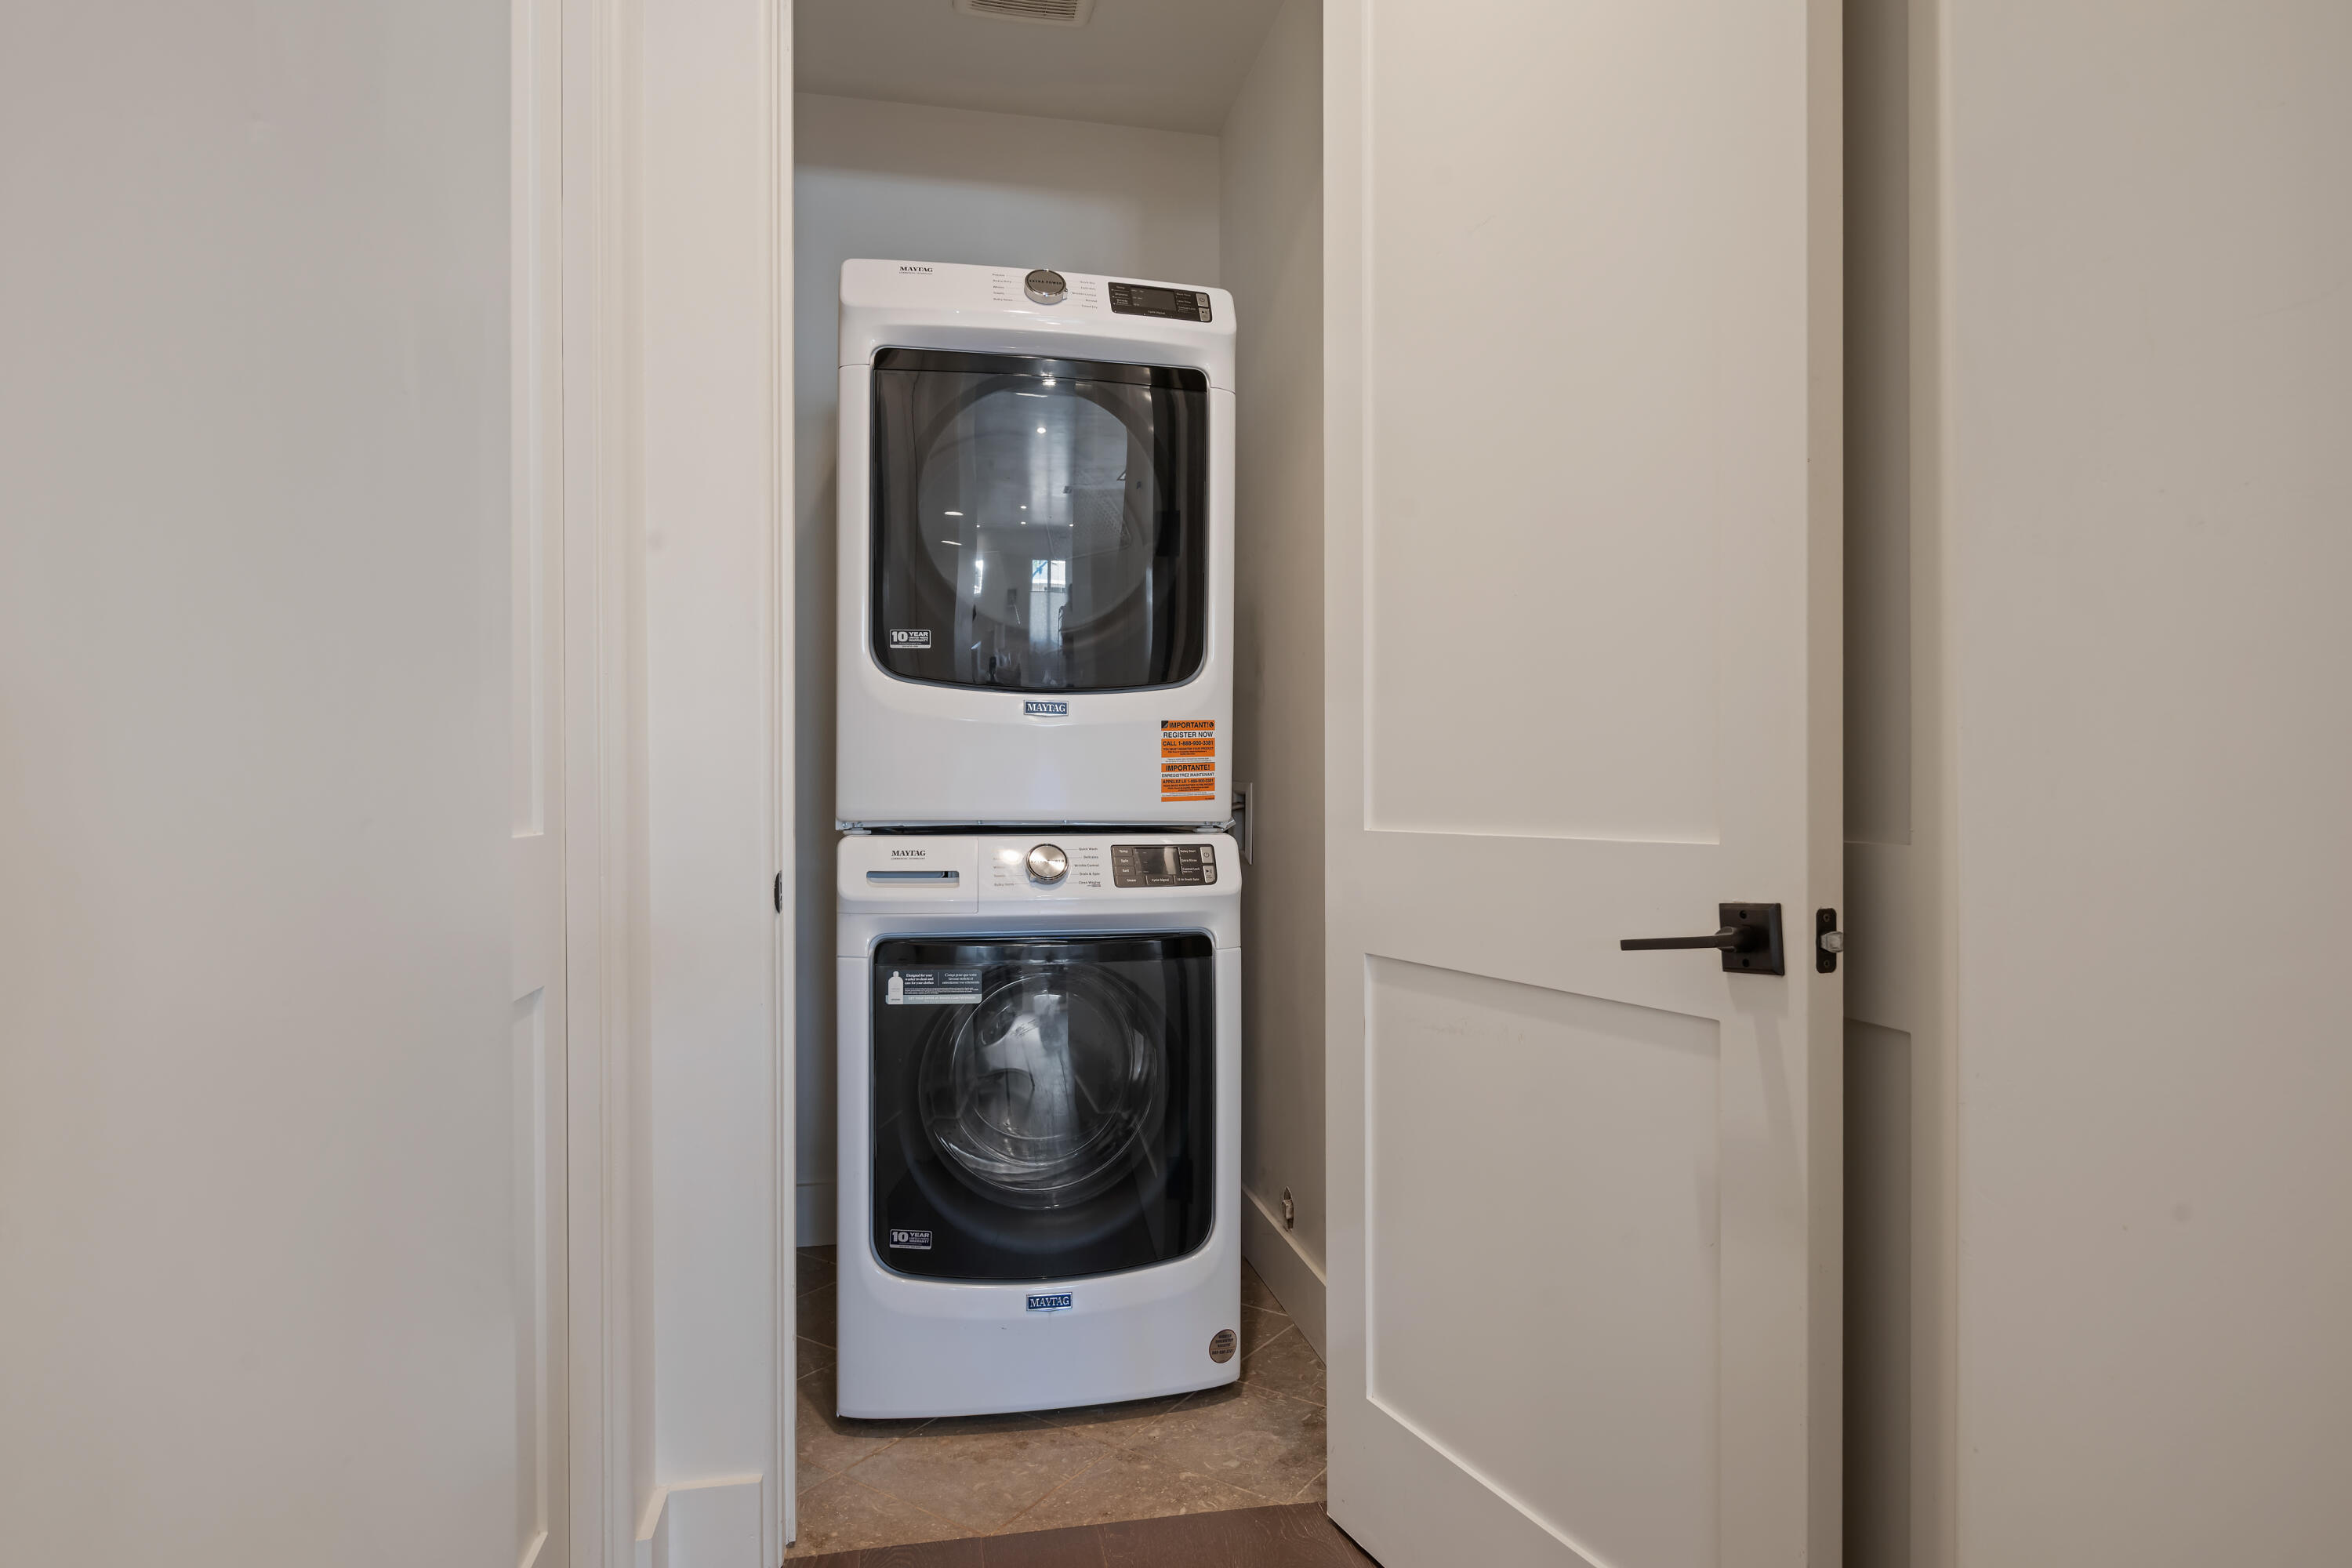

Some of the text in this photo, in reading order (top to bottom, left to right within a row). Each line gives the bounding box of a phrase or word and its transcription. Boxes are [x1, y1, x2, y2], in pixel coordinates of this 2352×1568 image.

[891, 631, 908, 642] 10
[1027, 703, 1065, 713] MAYTAG
[892, 1231, 909, 1243] 10
